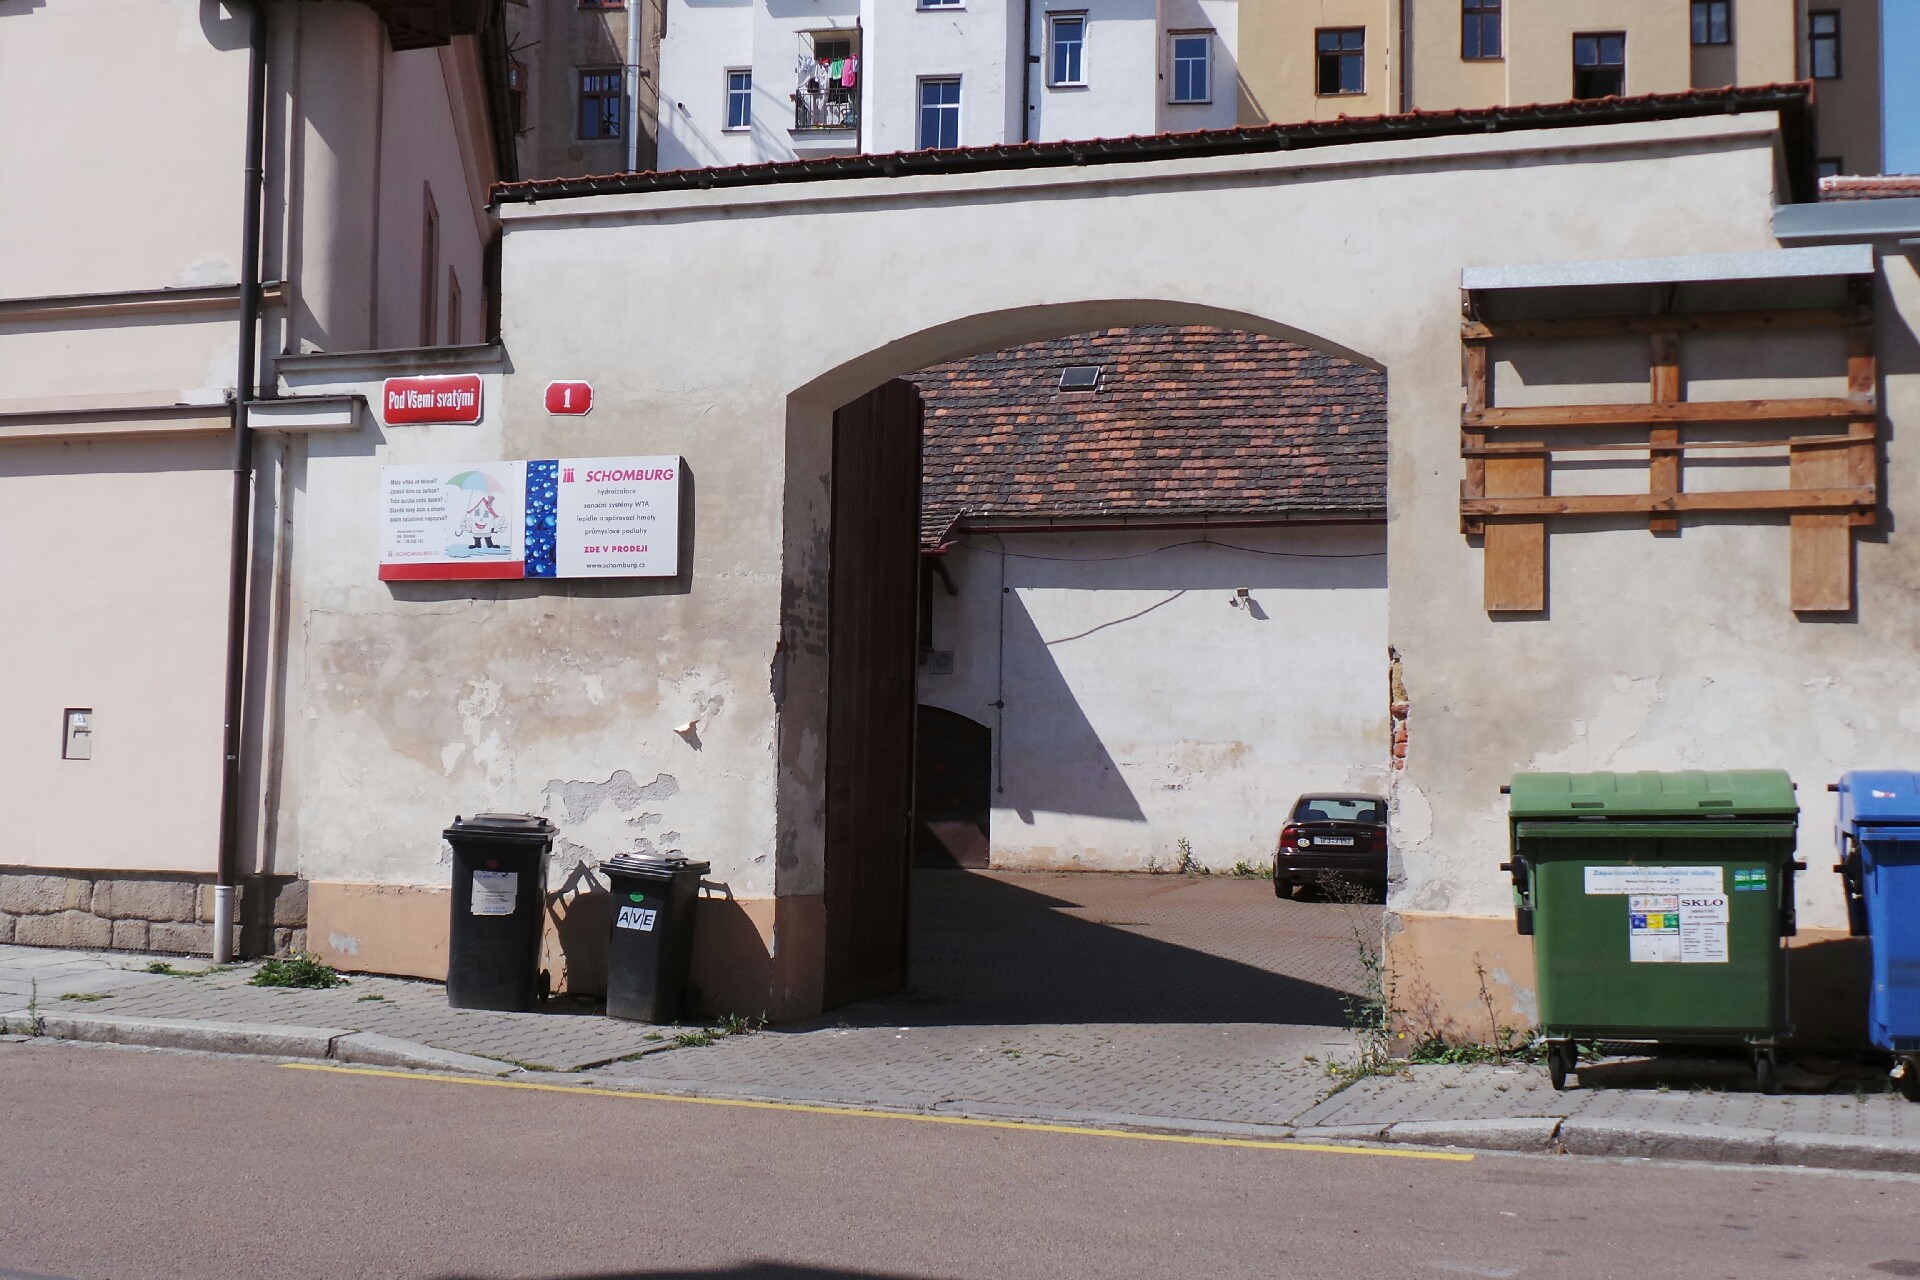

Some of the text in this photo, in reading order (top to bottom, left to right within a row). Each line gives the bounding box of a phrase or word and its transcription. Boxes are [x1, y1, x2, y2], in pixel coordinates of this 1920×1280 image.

[389, 388, 474, 410] Pod Všemi svatými
[563, 388, 571, 408] 1
[585, 469, 674, 482] SCHOMBURG
[597, 488, 636, 496] hydroizolace
[609, 501, 633, 509] systémy
[605, 514, 635, 522] spárovací
[636, 514, 656, 522] hmoty
[584, 528, 620, 536] průmyslové
[602, 545, 609, 553] V
[611, 545, 648, 553] PRODEJI
[1681, 899, 1724, 907] SKLO
[618, 911, 654, 926] AVE
